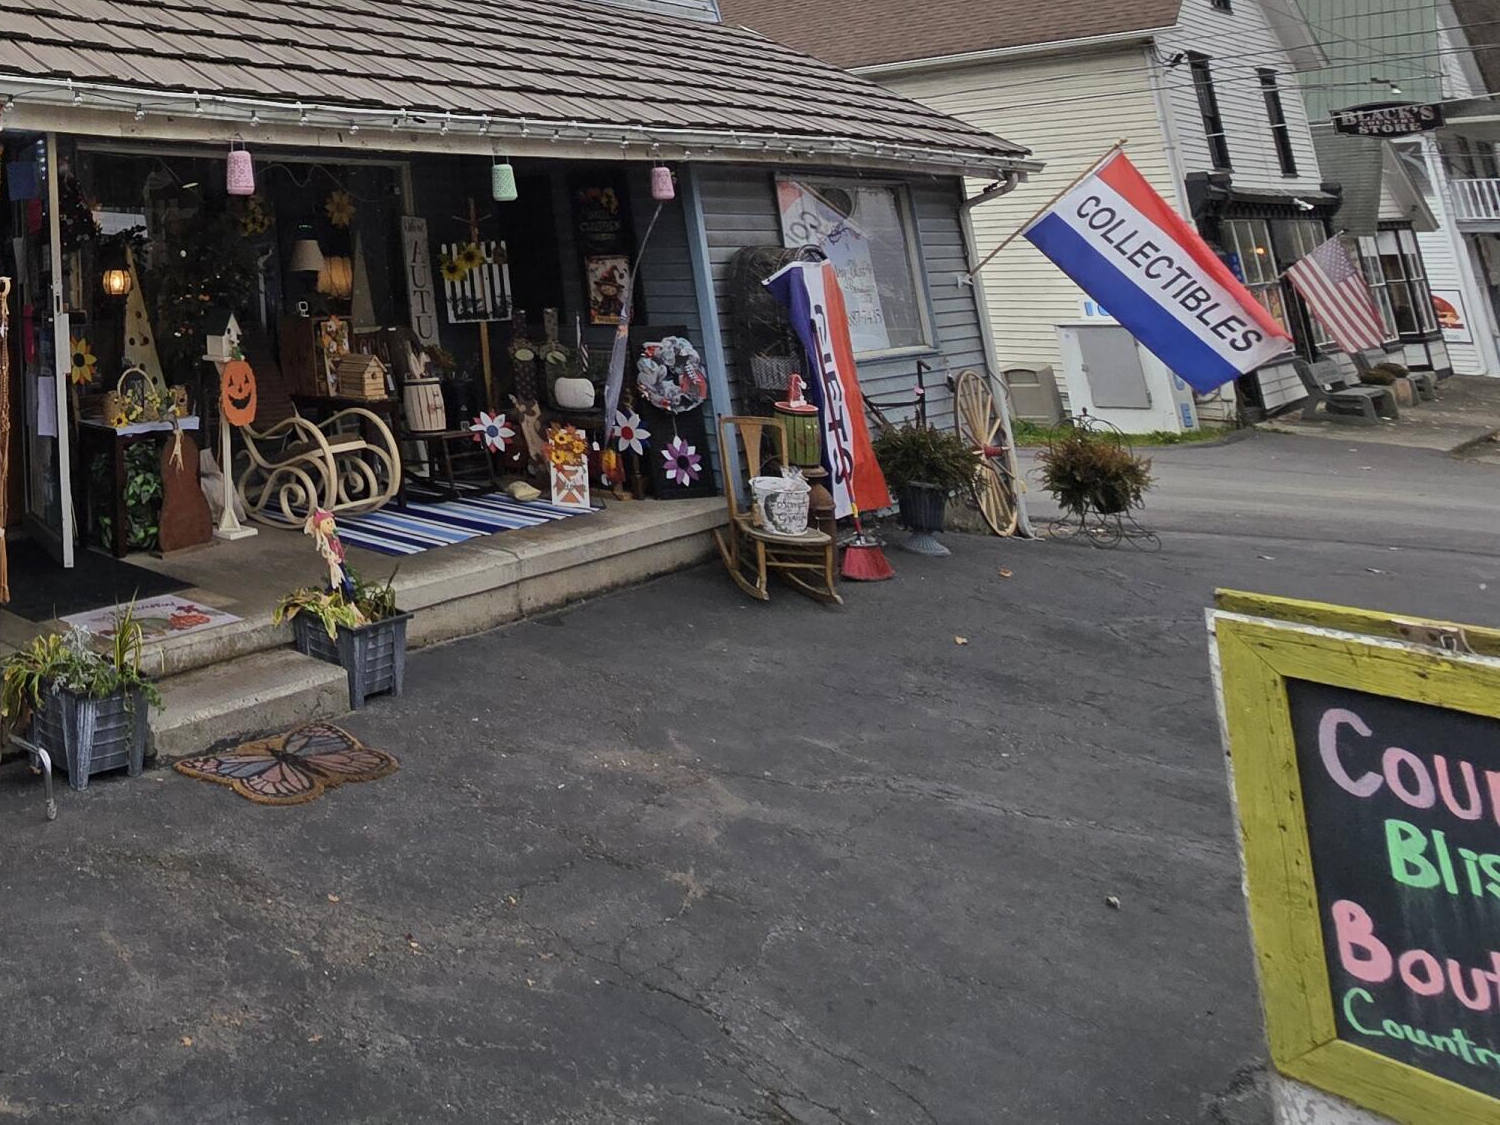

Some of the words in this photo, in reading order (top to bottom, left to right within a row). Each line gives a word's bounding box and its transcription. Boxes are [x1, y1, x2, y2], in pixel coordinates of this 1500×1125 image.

[1341, 105, 1435, 126] BLACK'S
[1358, 122, 1422, 135] STORE
[409, 239, 433, 340] AUTU
[1076, 195, 1263, 352] COLLECTIBLES
